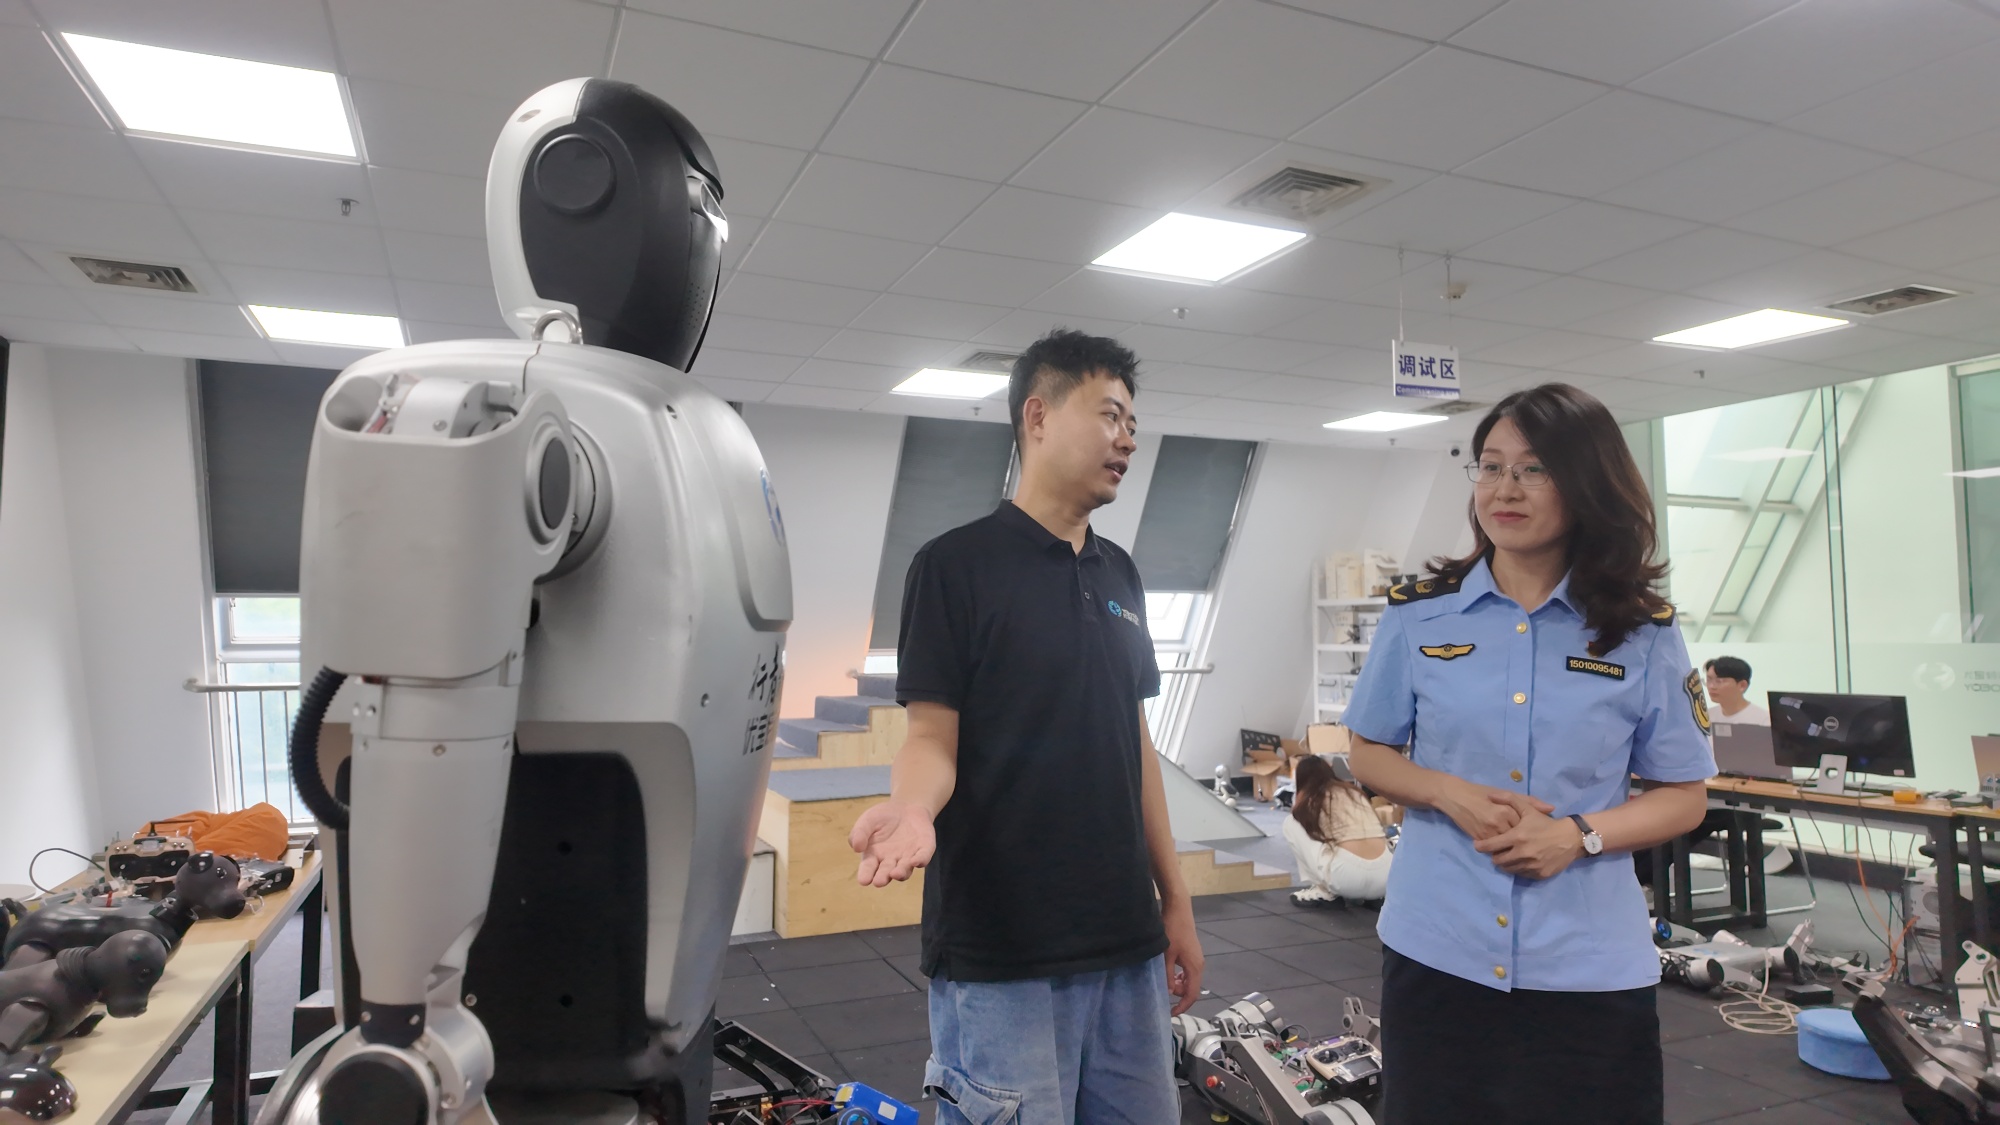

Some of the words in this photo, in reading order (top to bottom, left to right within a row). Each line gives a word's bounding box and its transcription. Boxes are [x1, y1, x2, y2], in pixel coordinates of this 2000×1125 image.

[1398, 354, 1456, 380] 调试区
[1569, 659, 1623, 677] 15010095481
